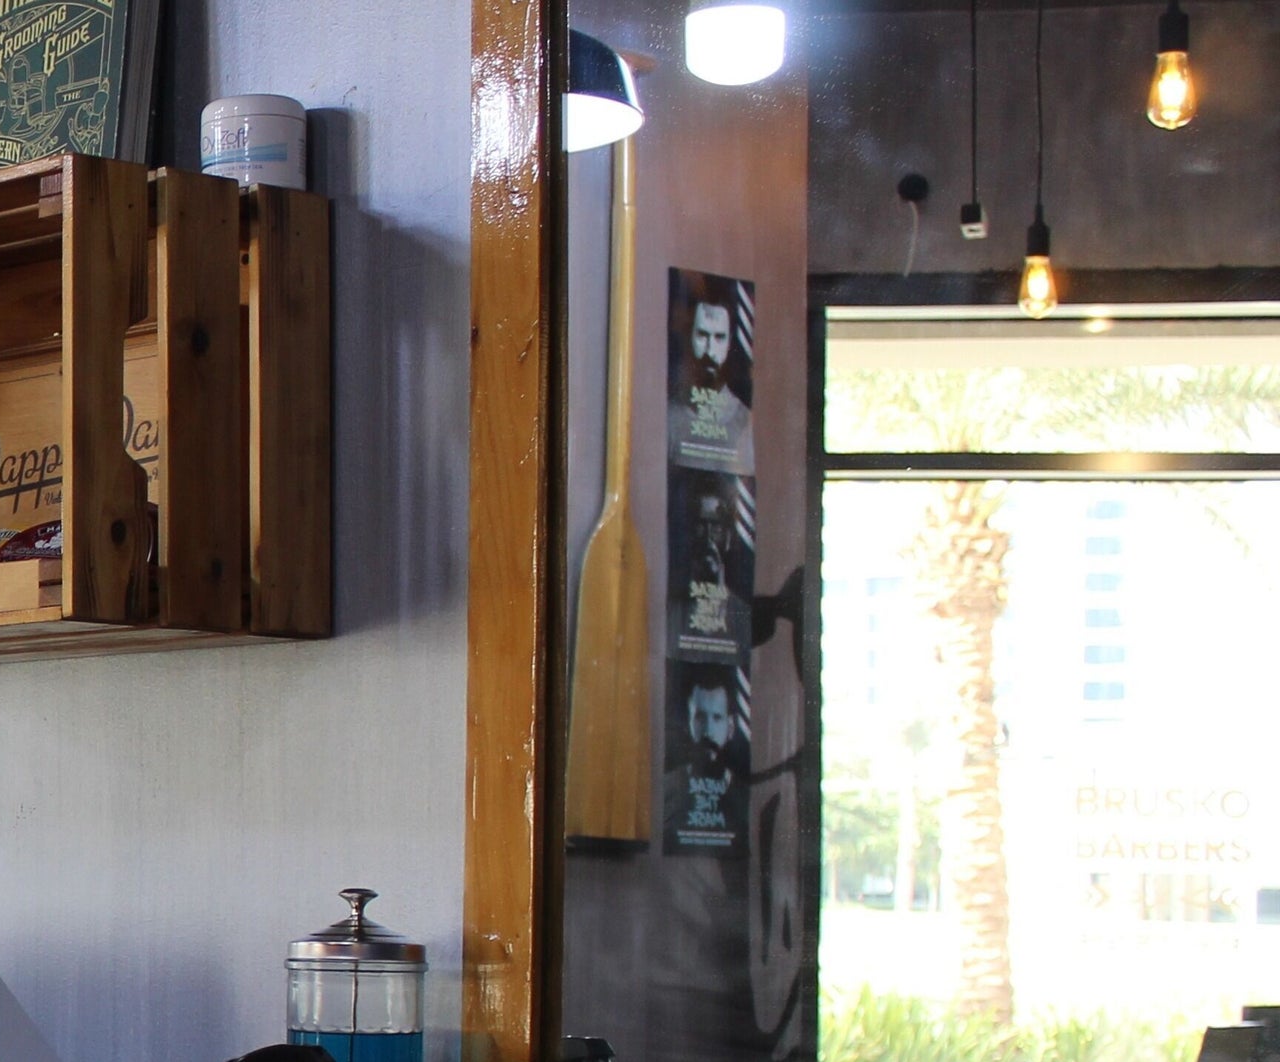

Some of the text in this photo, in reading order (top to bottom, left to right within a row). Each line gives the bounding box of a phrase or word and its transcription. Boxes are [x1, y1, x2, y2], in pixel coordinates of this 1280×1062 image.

[43, 22, 91, 77] GUIDE
[63, 90, 82, 102] THE
[1075, 786, 1250, 818] BRUSKO
[1075, 832, 1252, 862] BARBERS
